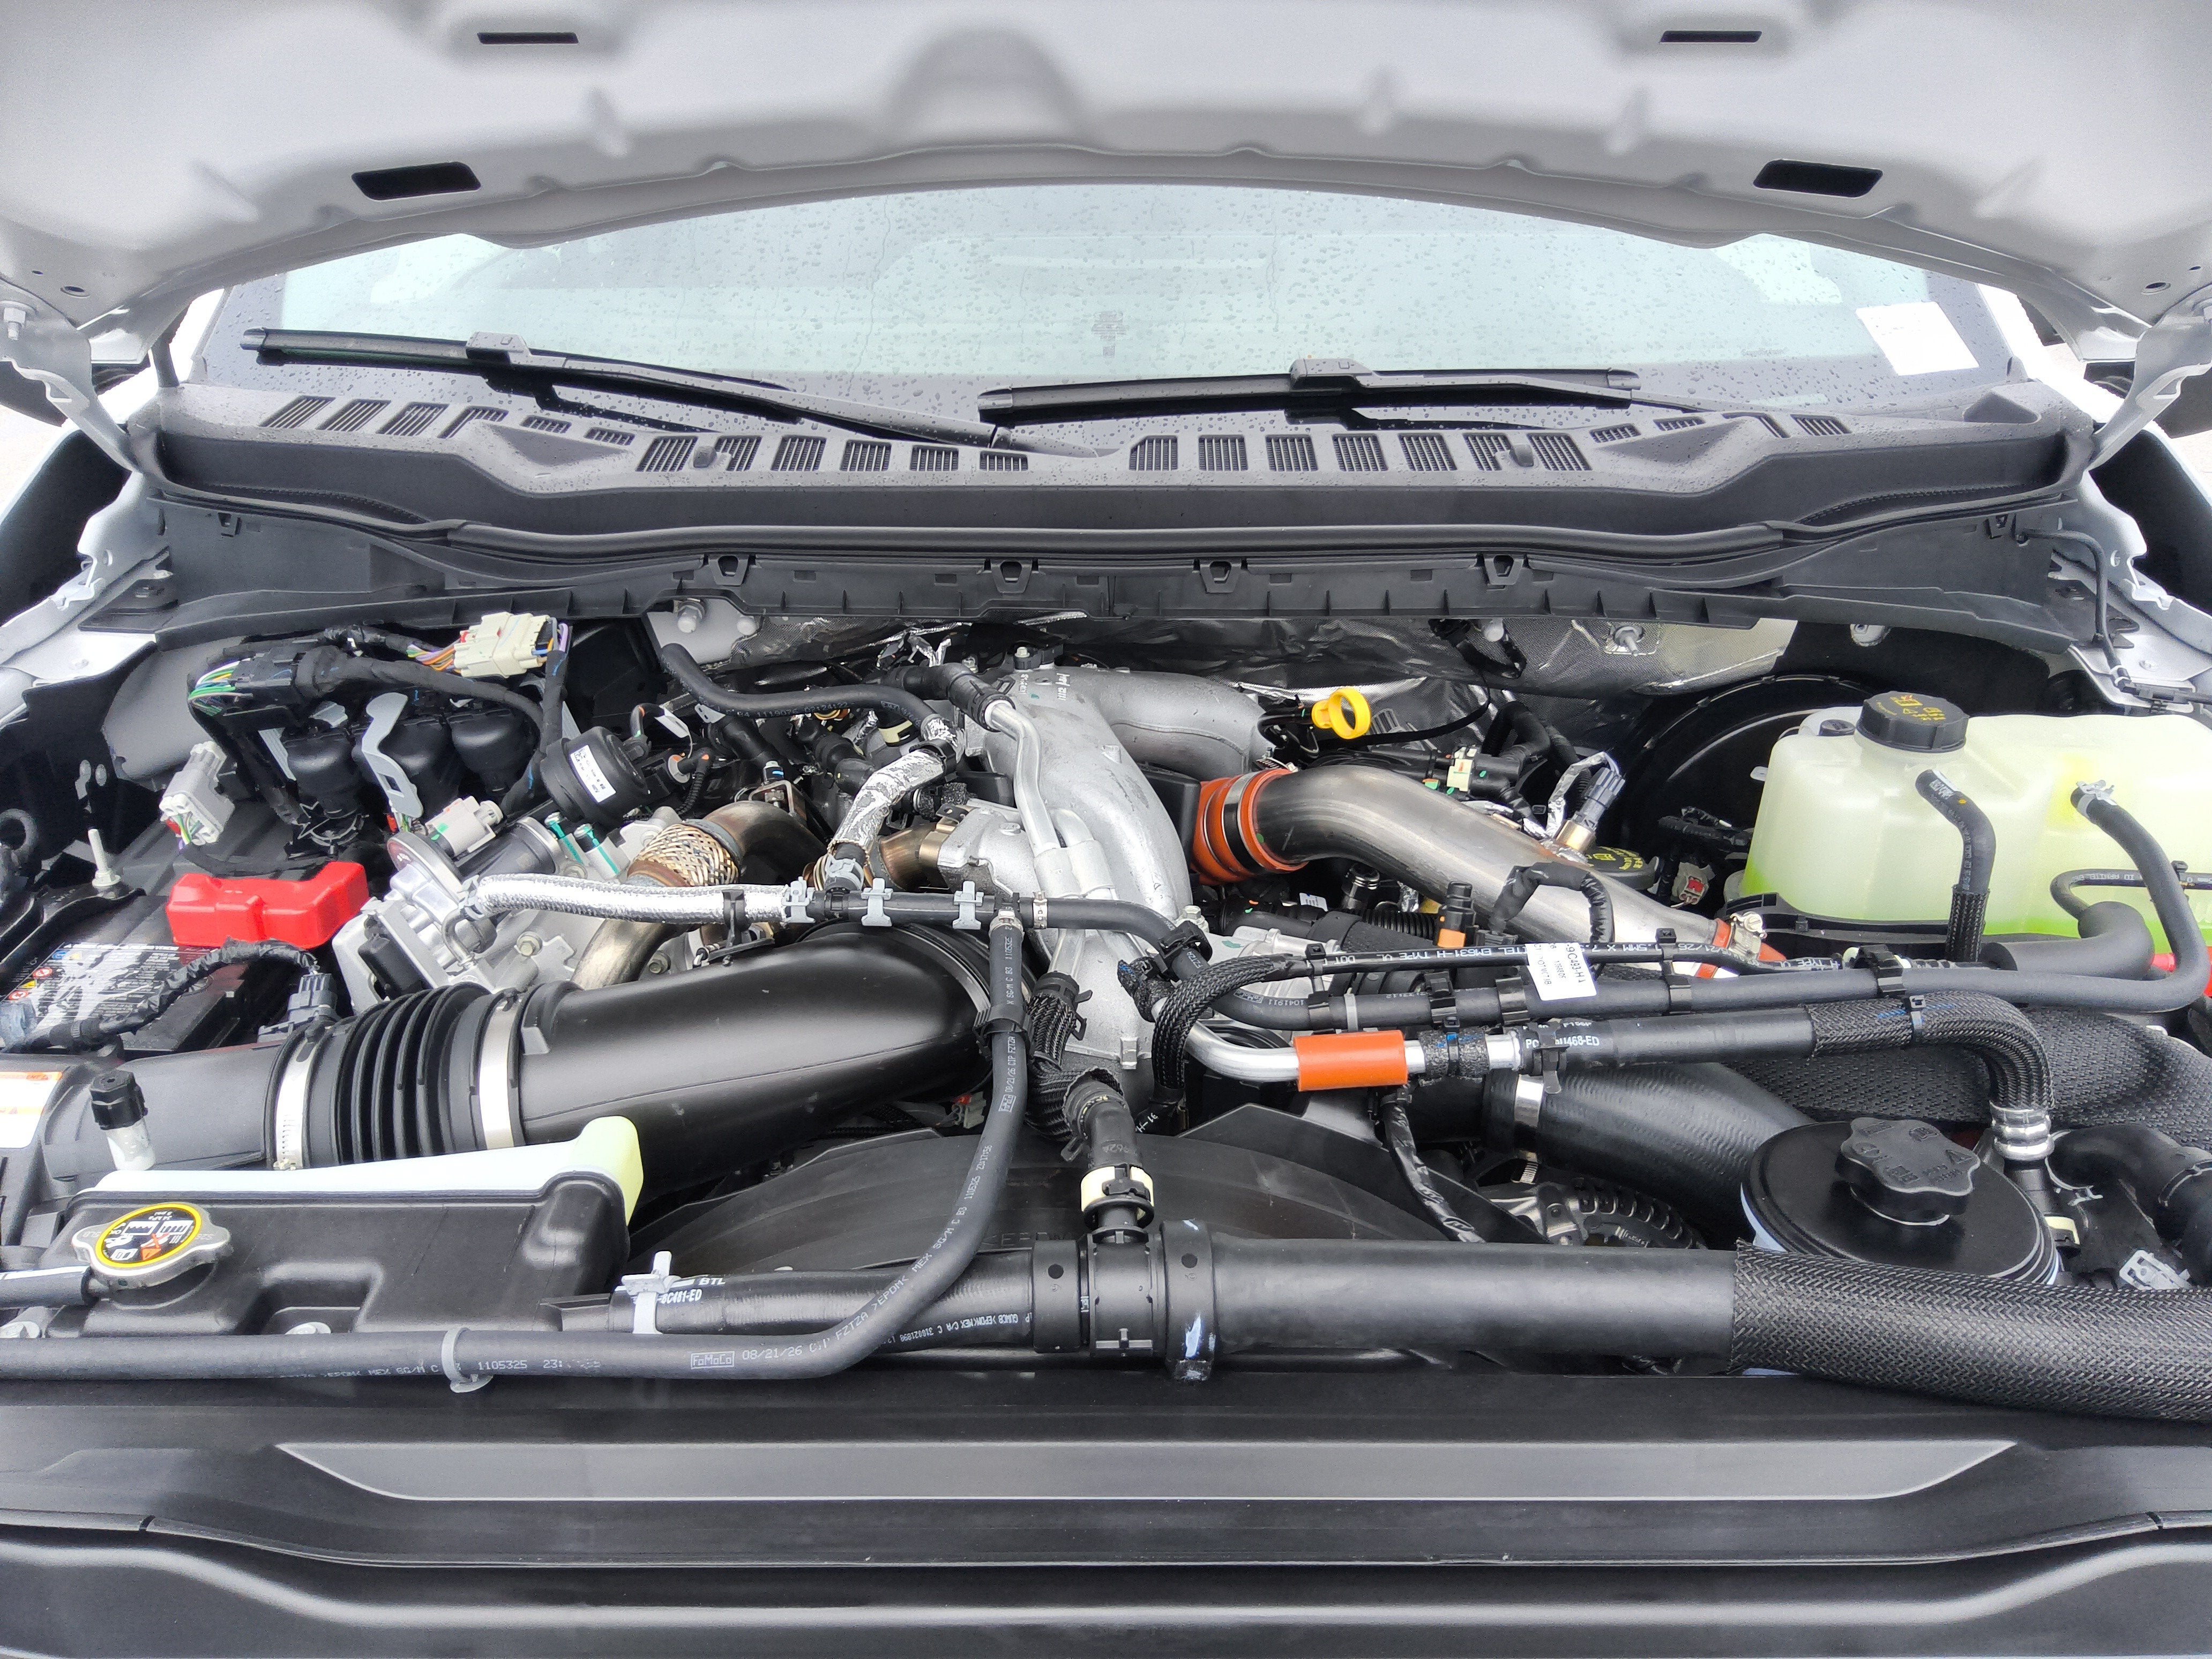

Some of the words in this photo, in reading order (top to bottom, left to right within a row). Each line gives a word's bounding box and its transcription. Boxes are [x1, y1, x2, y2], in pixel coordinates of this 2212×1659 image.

[1333, 955, 1356, 966] DOT
[1399, 951, 1431, 961] TYPE
[1267, 998, 1304, 1007] 1041911
[698, 1277, 726, 1286] BTL
[691, 1352, 734, 1369] FoMoCo
[742, 1345, 803, 1361] 08/21/26
[835, 1311, 869, 1340] FZTZA
[911, 1252, 933, 1272] MEX
[431, 1364, 439, 1372] C
[477, 1359, 528, 1371] 1105325
